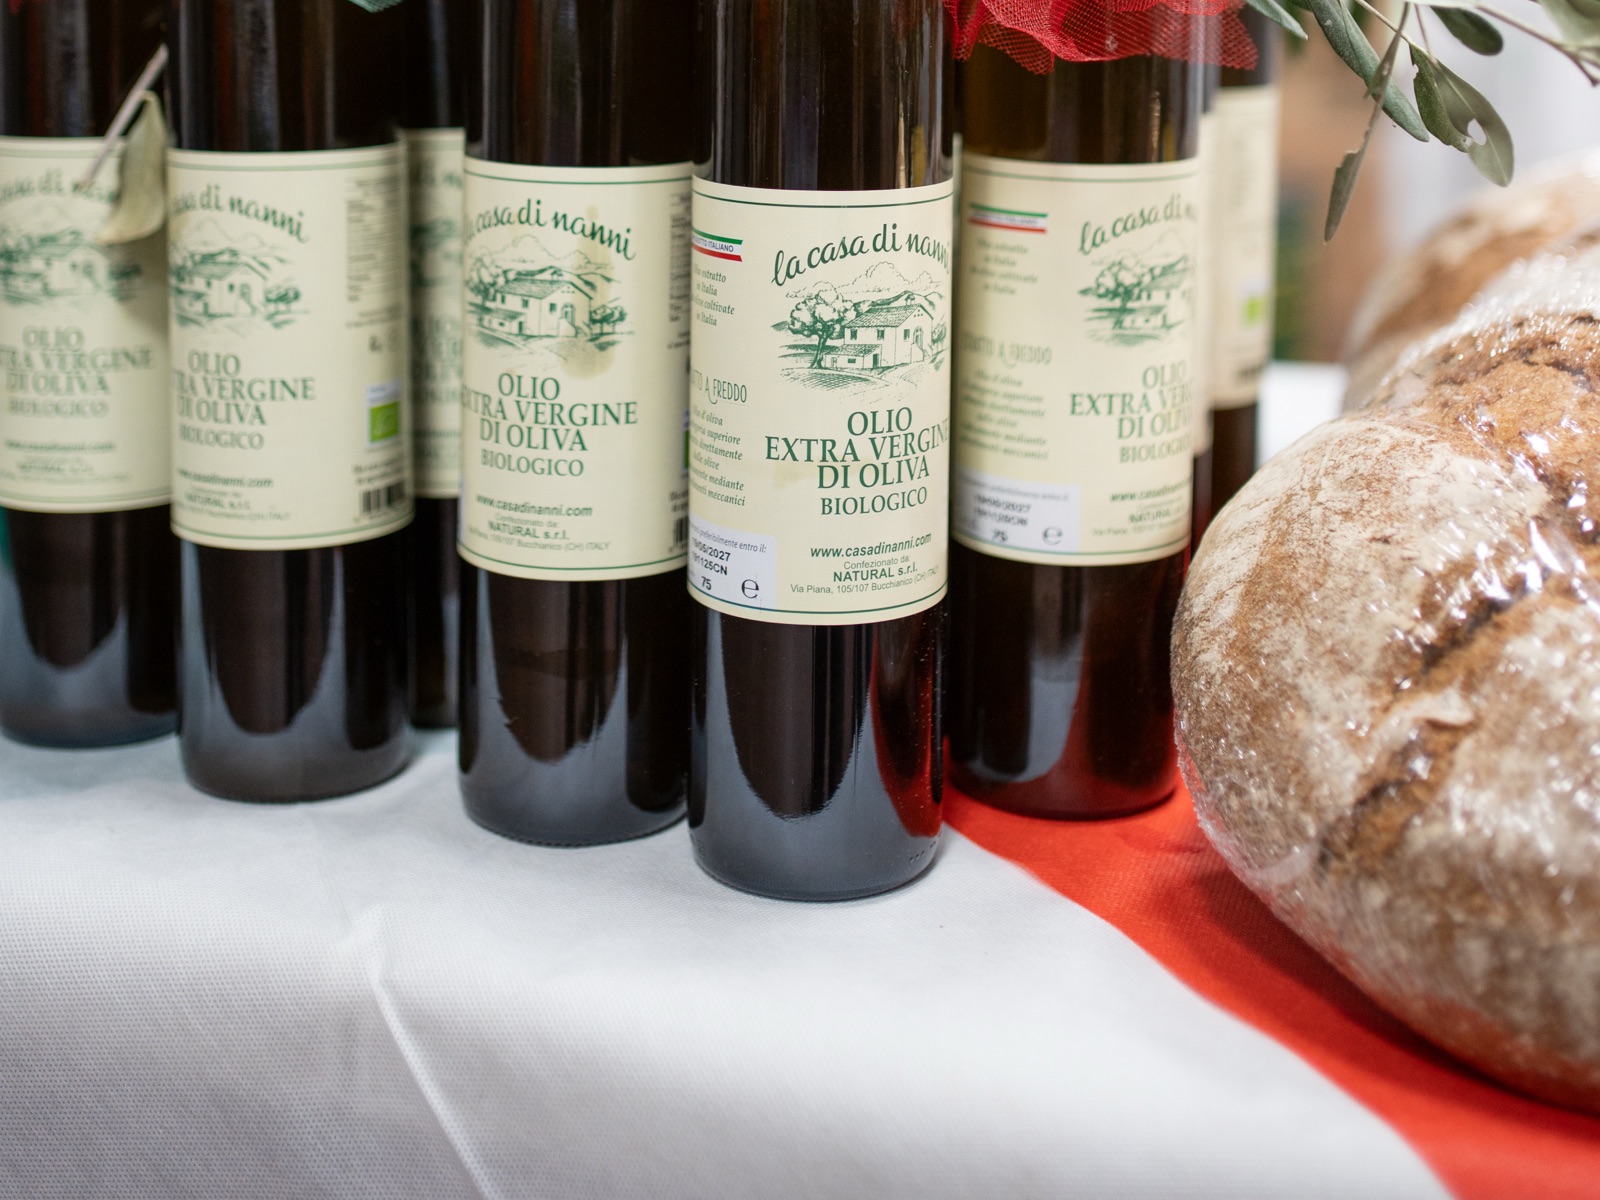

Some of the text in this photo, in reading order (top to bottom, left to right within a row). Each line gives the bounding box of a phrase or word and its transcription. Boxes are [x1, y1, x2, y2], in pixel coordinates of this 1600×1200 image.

[201, 184, 224, 211] di
[229, 195, 310, 243] nanni
[1078, 220, 1110, 256] la
[1112, 204, 1160, 238] casa
[1163, 193, 1182, 221] di
[518, 198, 547, 227] di
[550, 211, 637, 261] nanni
[708, 241, 734, 253] ITALIANO
[771, 249, 806, 287] la
[806, 236, 869, 269] casa
[872, 223, 902, 253] di
[702, 267, 727, 283] estratto
[702, 282, 718, 296] Italia
[704, 300, 735, 315] coltivate
[22, 325, 84, 351] OLIO
[41, 347, 153, 374] VERGINE
[187, 350, 241, 377] OLIO
[32, 371, 110, 396] OLIVA
[498, 373, 560, 401] OLIO
[1141, 360, 1187, 390] OLIO
[202, 377, 316, 402] VERGINE
[712, 378, 747, 403] FREDDO
[195, 398, 266, 425] OLIVA
[514, 401, 638, 427] VERGINE
[1069, 392, 1152, 416] EXTRA
[847, 406, 913, 436] OLIO
[1117, 415, 1145, 440] DI
[178, 422, 265, 450] BIOLOGICO
[479, 417, 501, 445] DI
[506, 424, 588, 451] OLIVA
[706, 428, 741, 445] superiore
[699, 440, 743, 461] direttamente
[765, 436, 861, 463] EXTRA
[481, 449, 585, 477] BIOLOGICO
[817, 464, 850, 489] DI
[859, 455, 930, 488] OLIVA
[708, 474, 744, 492] mediante
[476, 494, 593, 517] www.casadinanni.com
[707, 487, 746, 507] meccanici
[820, 486, 928, 515] BIOLOGICO
[488, 520, 540, 539] NATURAL
[739, 542, 758, 552] entro
[810, 532, 932, 558] www.casadinanni.com
[833, 561, 918, 582] NATURAL s.r.l.
[843, 554, 911, 570] Confezionato da:
[701, 575, 712, 591] 75
[790, 583, 804, 594] Via
[806, 585, 834, 595] Piana,
[836, 583, 869, 595] 105/107
[871, 578, 913, 591] Bucchianico
